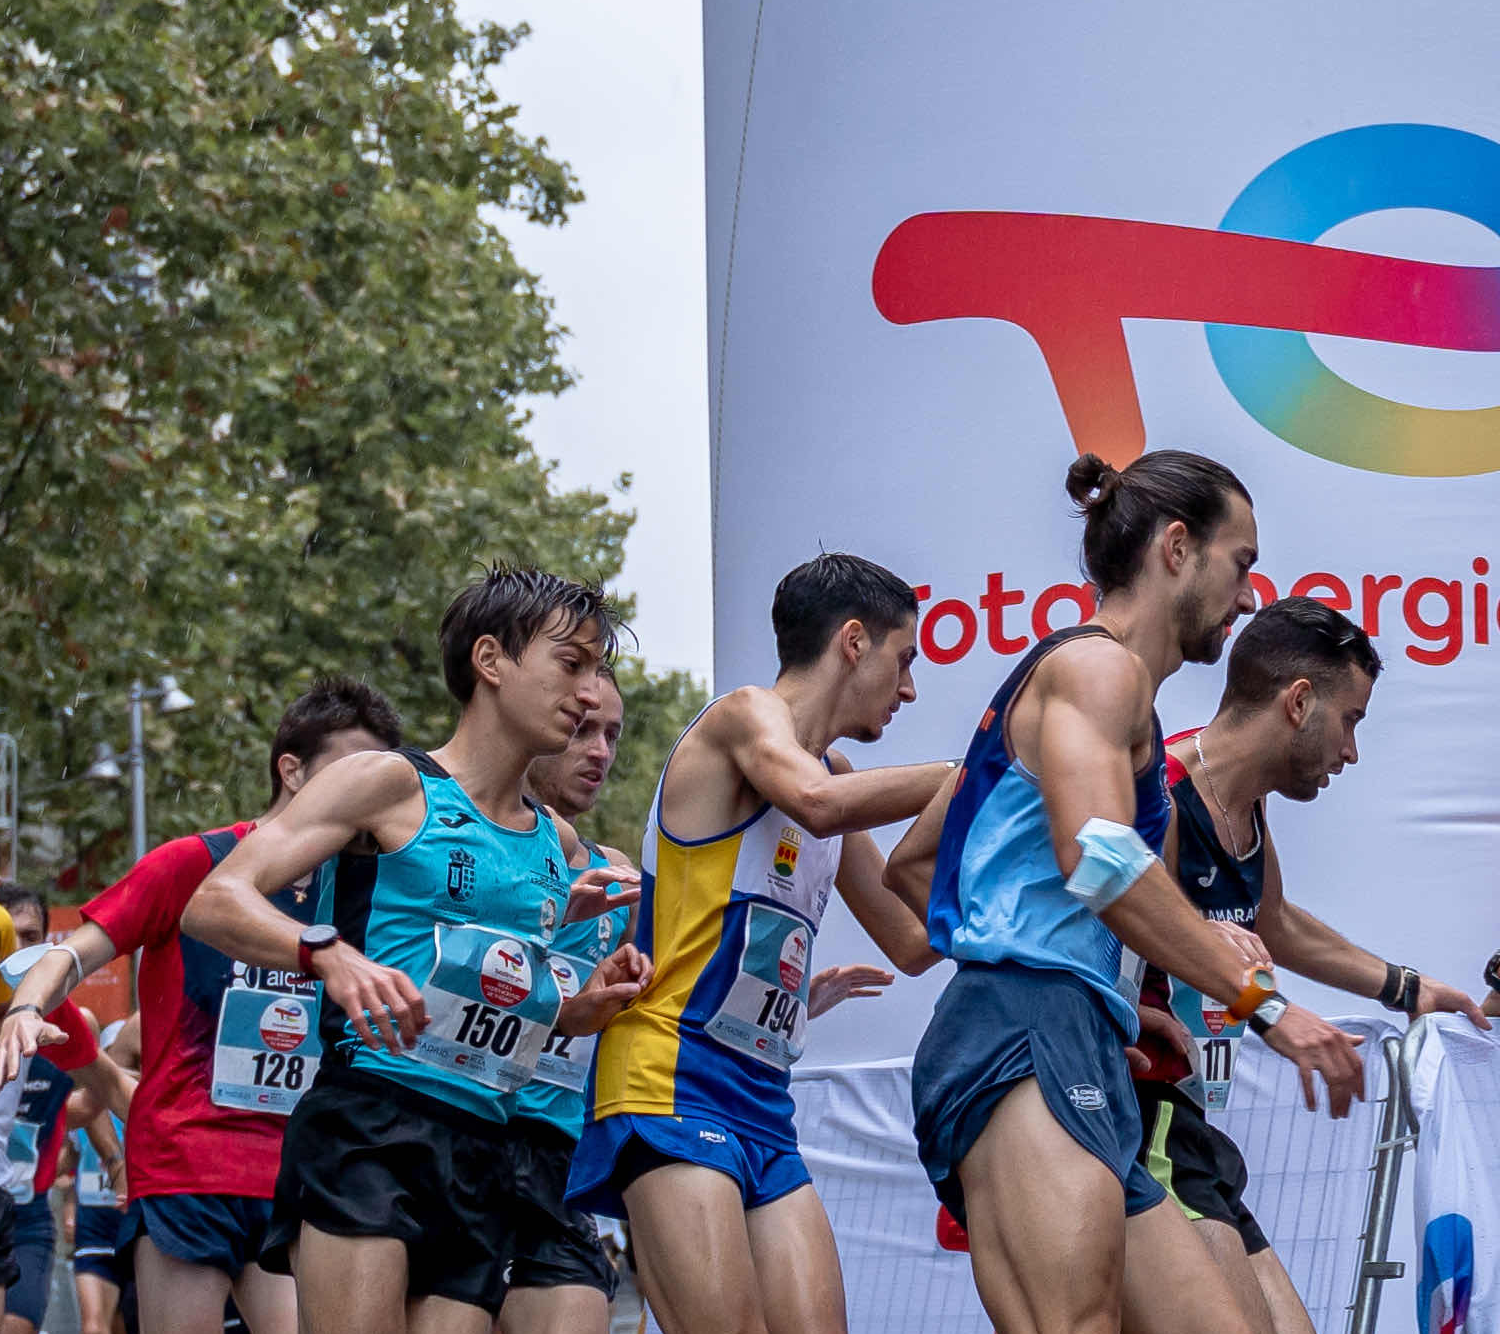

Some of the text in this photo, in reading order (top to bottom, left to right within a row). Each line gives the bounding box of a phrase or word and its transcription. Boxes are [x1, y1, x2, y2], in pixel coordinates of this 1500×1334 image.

[455, 1003, 522, 1057] 150
[756, 987, 800, 1040] 194
[252, 1051, 305, 1090] 128
